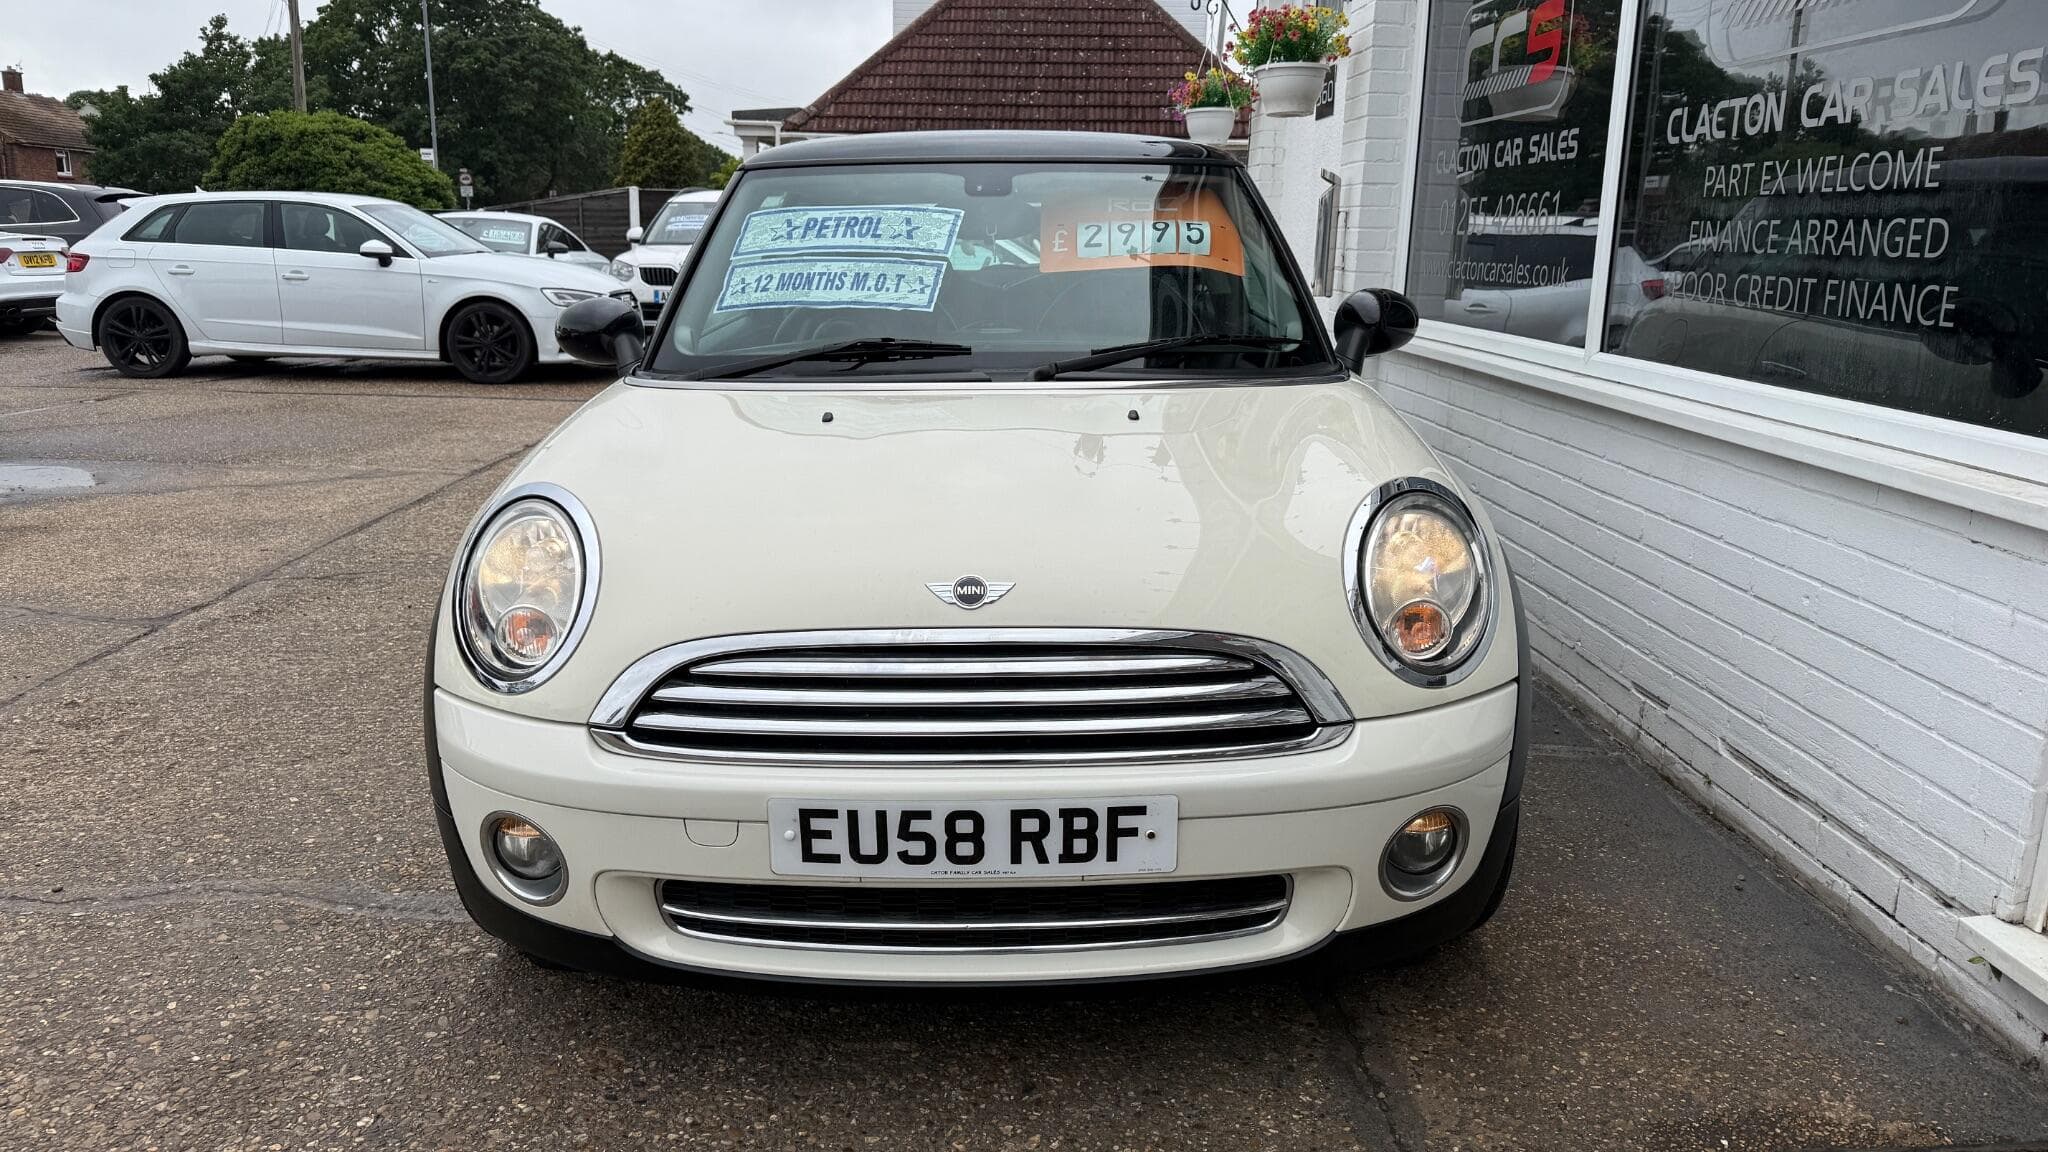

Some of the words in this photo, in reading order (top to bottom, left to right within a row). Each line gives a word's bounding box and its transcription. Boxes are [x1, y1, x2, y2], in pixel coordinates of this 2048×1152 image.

[1667, 89, 1787, 144] CLACTON
[1801, 76, 1874, 128] CAR
[1892, 47, 2046, 118] SALES
[1437, 143, 1490, 174] CLACTON
[1494, 137, 1523, 168] CAR
[1528, 127, 1580, 164] SALES
[1703, 162, 1755, 197] PART
[1760, 159, 1790, 196] EX
[1797, 146, 1945, 193] WELCOME
[801, 217, 882, 239] PETROL
[1439, 195, 1489, 236] 01255
[1491, 190, 1561, 235] 426661
[1689, 219, 1781, 254] FINANCE
[1786, 217, 1950, 259] ARRANGED
[754, 274, 773, 293] 12
[776, 272, 847, 292] MONTHS
[1423, 253, 1569, 288] www.clactoncarsales.co.uk
[1672, 271, 1727, 305] POOR
[1733, 275, 1817, 313] CREDIT
[1823, 279, 1959, 328] FINANCE
[957, 586, 984, 595] MINI
[798, 807, 985, 866] EU58
[1010, 805, 1147, 865] RBF
